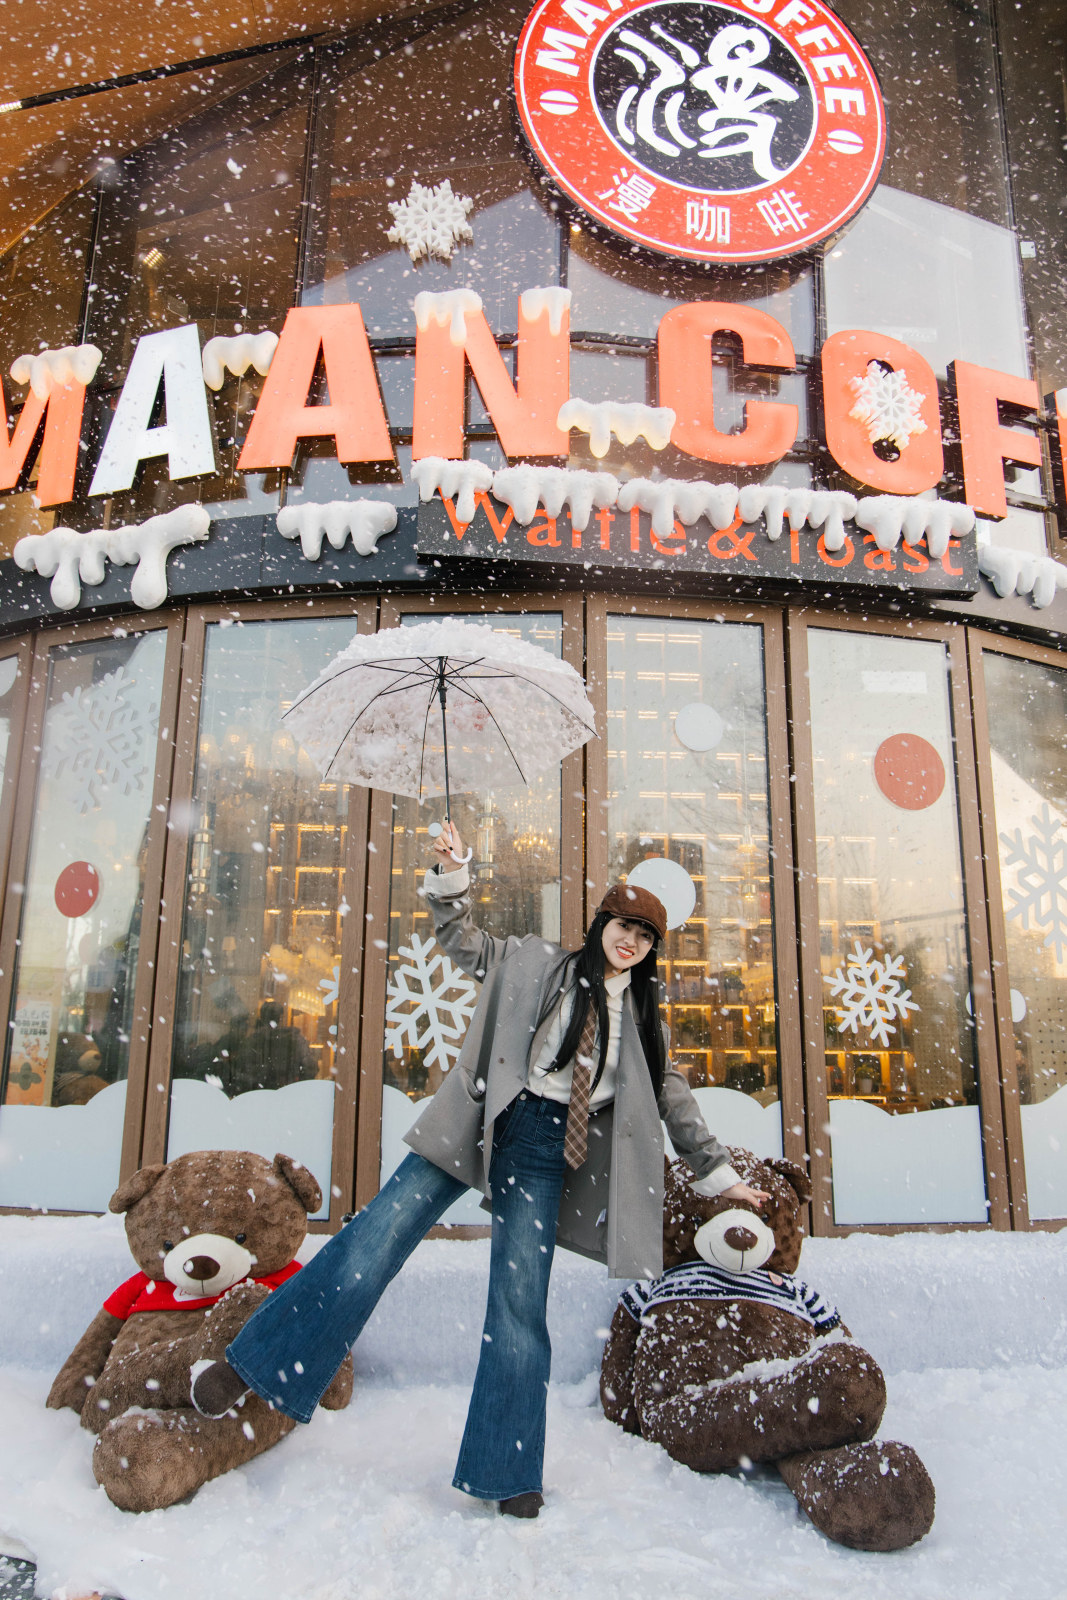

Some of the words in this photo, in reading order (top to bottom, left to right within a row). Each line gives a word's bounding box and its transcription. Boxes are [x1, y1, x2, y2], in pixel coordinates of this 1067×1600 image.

[535, 0, 624, 77] MA
[598, 167, 810, 244] 漫咖啡
[658, 301, 1067, 519] COF
[437, 485, 687, 556] Wafle
[707, 506, 758, 561] &
